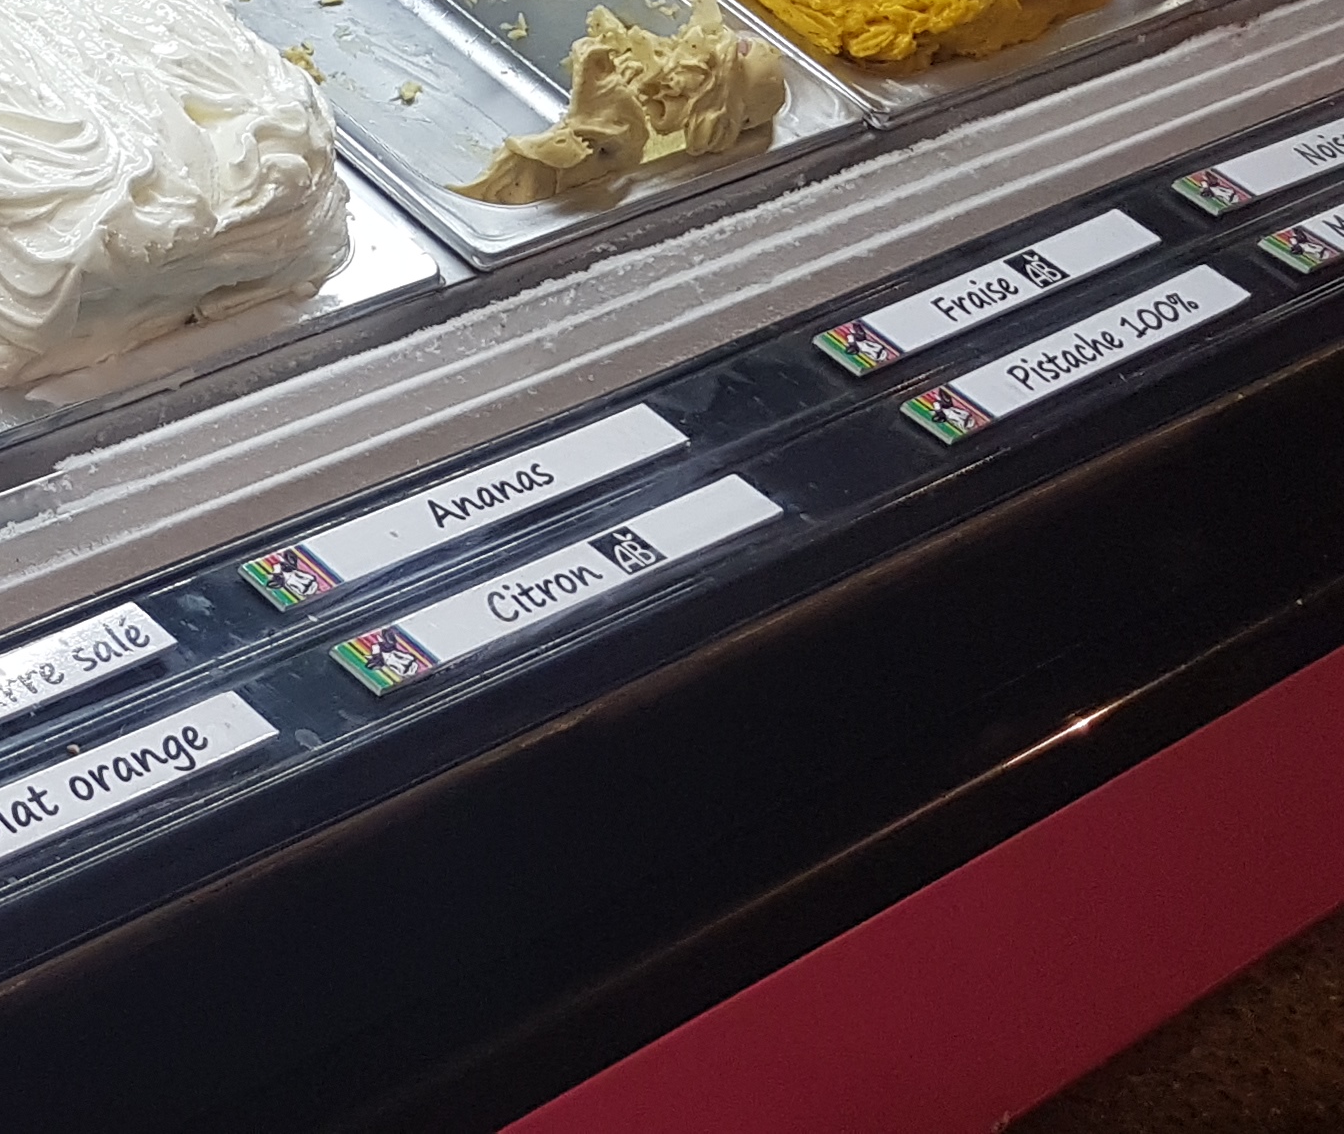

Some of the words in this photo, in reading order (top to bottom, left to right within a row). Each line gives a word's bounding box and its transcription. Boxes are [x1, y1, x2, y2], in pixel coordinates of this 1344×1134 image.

[930, 276, 1019, 323] Fraise
[1006, 327, 1125, 391] Pistache
[1120, 291, 1200, 341] 100%
[424, 461, 556, 530] Ananas
[486, 559, 604, 624] Citron
[72, 614, 151, 672] salé
[68, 719, 210, 803] orange
